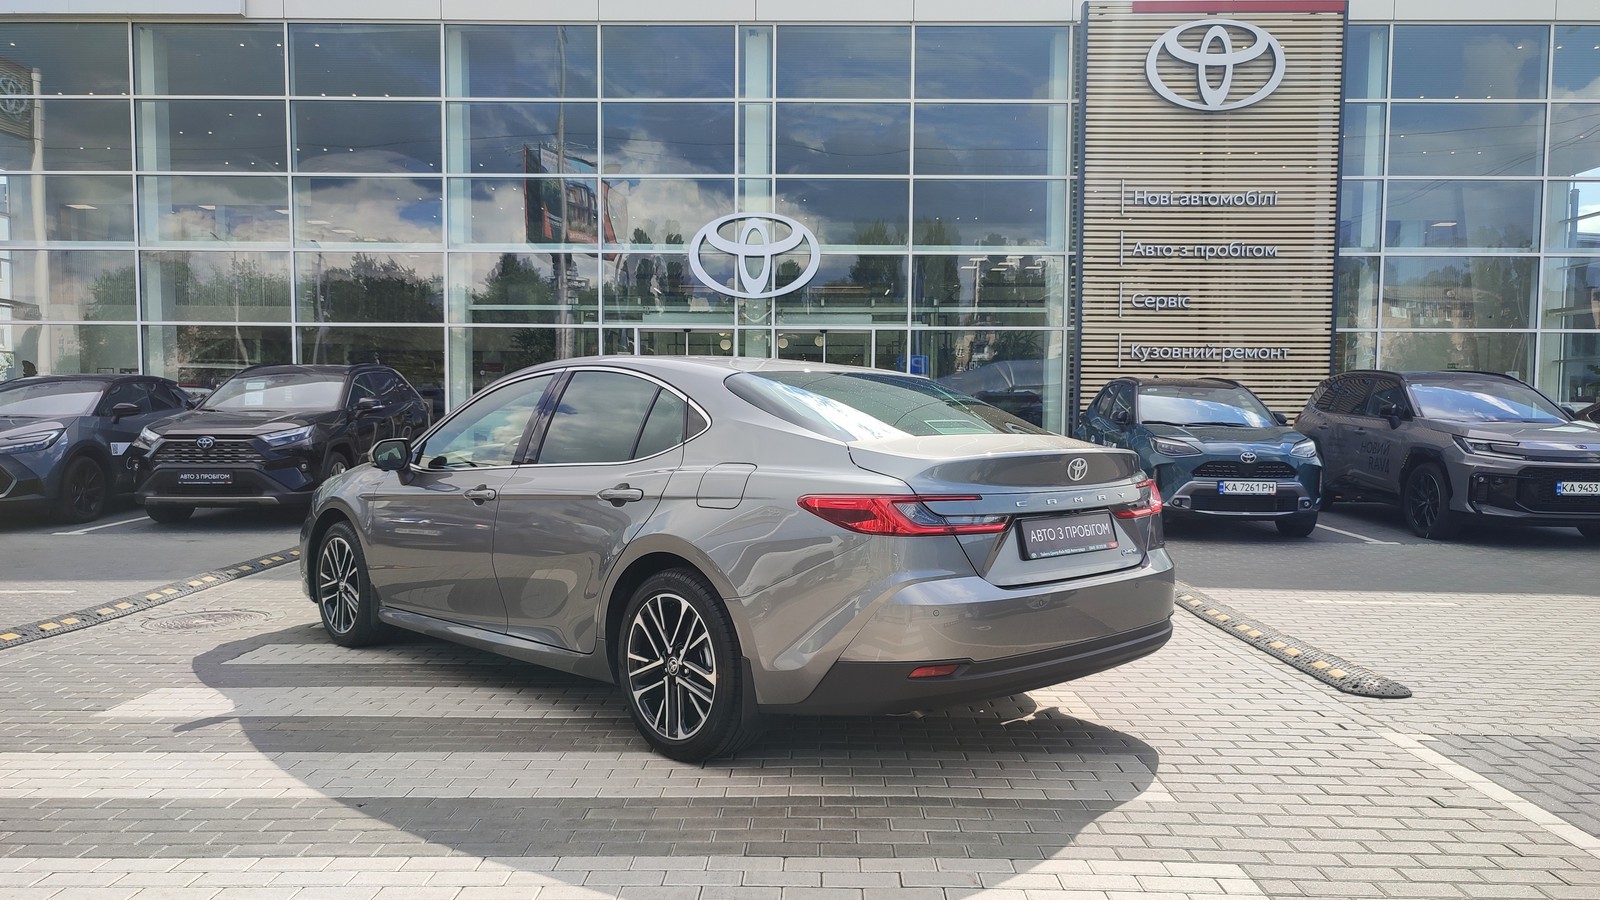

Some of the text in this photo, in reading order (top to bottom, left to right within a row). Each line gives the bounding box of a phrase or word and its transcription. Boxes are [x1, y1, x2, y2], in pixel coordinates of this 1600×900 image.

[1133, 190, 1279, 206] Нові автомобілі
[1132, 242, 1279, 261] Авто з пробігом
[1131, 293, 1192, 312] Сервіс
[1130, 343, 1290, 362] Кузовний ремонт
[1240, 483, 1260, 491] 7261
[1577, 484, 1599, 492] 9453
[1016, 492, 1125, 507] CAMRY
[1030, 527, 1056, 543] АВТО
[1065, 523, 1111, 539] ПРОБІГОМ
